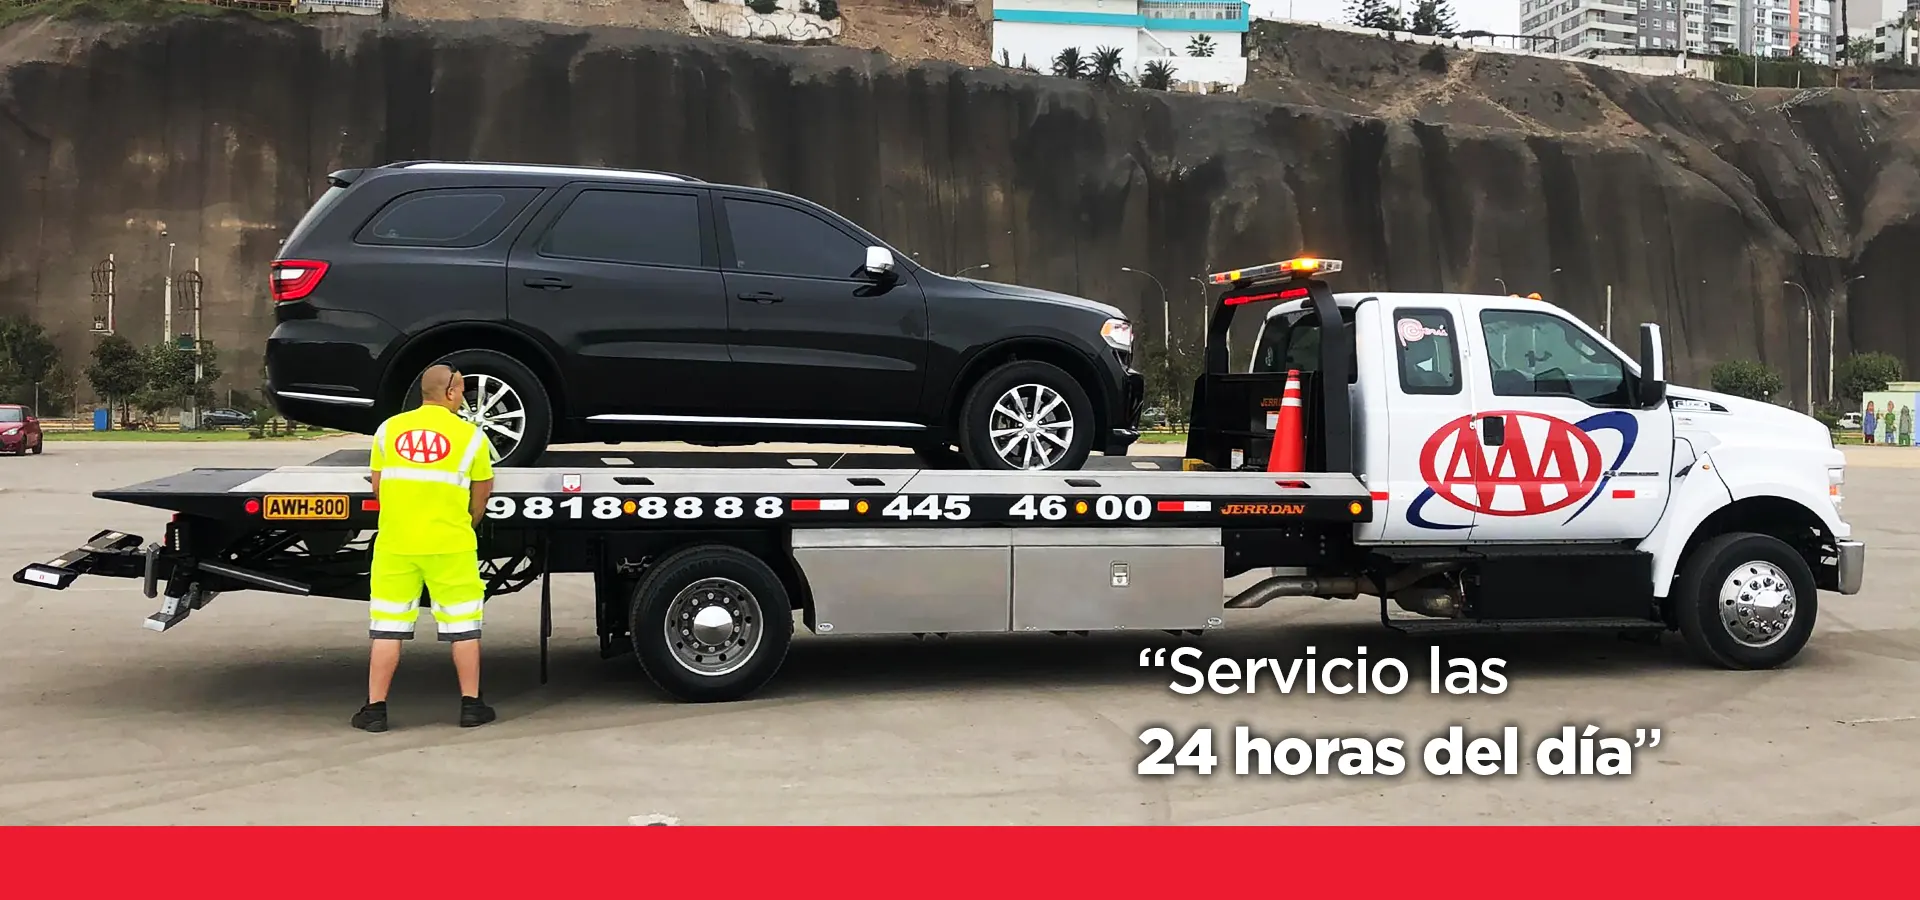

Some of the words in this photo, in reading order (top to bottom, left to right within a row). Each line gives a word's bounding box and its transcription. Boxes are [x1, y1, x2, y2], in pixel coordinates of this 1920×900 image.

[396, 429, 450, 463] AAA
[1428, 410, 1596, 517] AAA
[269, 499, 344, 515] AWH-800
[882, 494, 971, 520] 445
